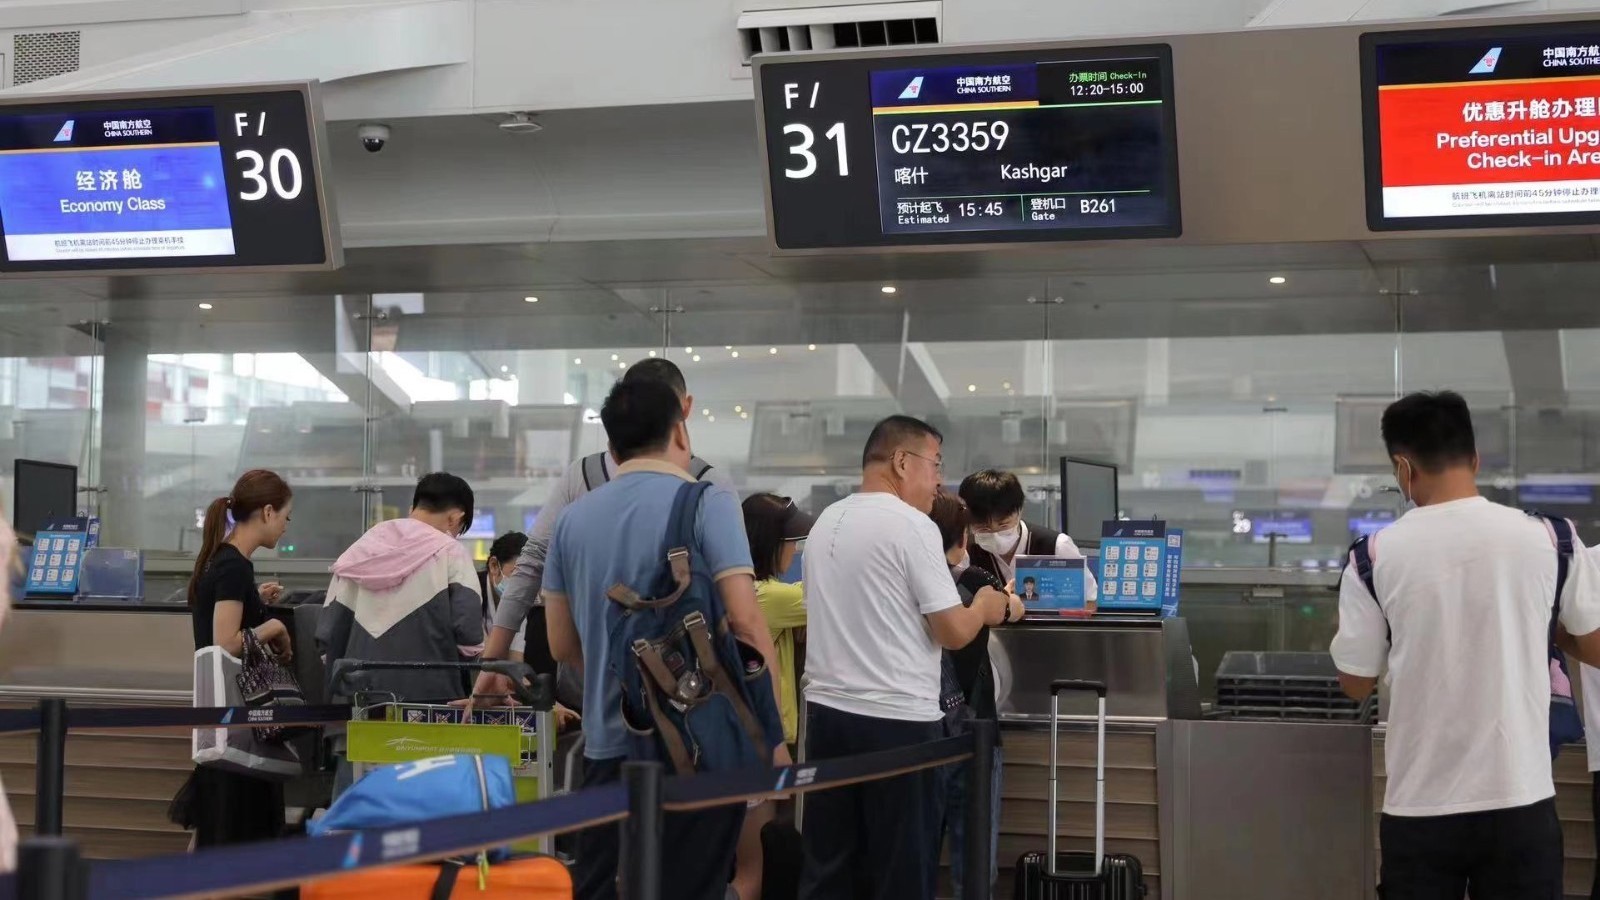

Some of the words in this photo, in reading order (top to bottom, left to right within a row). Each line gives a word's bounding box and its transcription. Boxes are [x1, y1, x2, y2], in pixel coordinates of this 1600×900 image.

[1543, 58, 1568, 67] CHINA
[956, 75, 1011, 87] 中国南方航空
[1068, 71, 1108, 83] 办票时间
[956, 85, 976, 94] CHINA
[977, 84, 1011, 93] SOUTHERN
[1462, 96, 1600, 123] 优惠升舱办理
[103, 119, 152, 131] 中国南方航空
[104, 130, 122, 138] CHINA
[122, 129, 153, 137] SOUTHERN
[891, 120, 1010, 154] CZ3359
[1436, 128, 1552, 149] Preferential
[783, 121, 850, 180] 31
[1467, 150, 1562, 169] Check-in
[75, 168, 143, 192] 经济舱
[235, 148, 302, 201] 30
[894, 168, 929, 185] 喀什
[1000, 163, 1068, 184] Kashgar
[60, 199, 123, 215] Economy
[127, 196, 166, 211] Class
[897, 201, 943, 215] 预计起飞
[958, 202, 1003, 217] 15:45
[1030, 198, 1066, 211] 登机口
[1080, 199, 1116, 214] B261
[898, 214, 949, 225] Estimated
[1031, 211, 1056, 222] Gate
